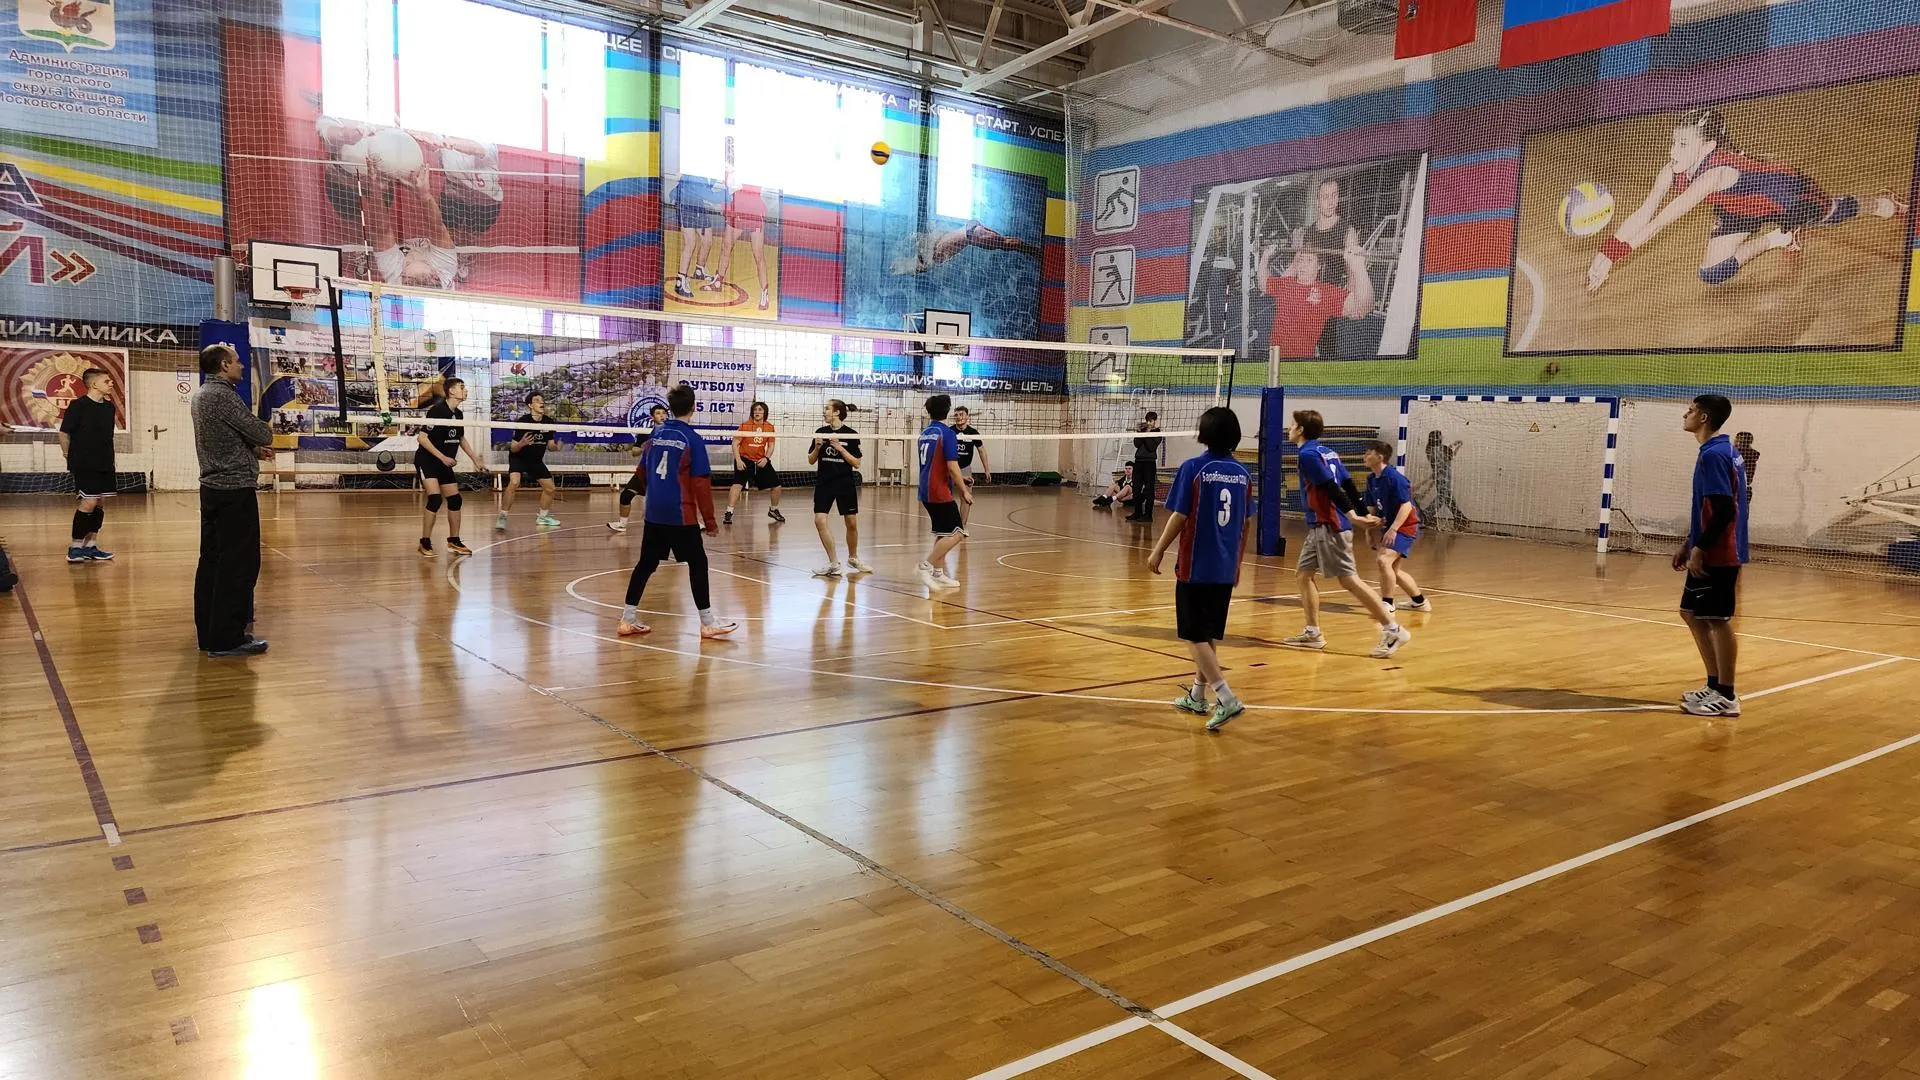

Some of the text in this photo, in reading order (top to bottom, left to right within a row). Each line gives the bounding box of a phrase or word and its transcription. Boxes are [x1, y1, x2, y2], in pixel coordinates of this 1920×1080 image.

[9, 49, 129, 78] Администрация
[28, 68, 112, 90] городского
[13, 81, 125, 106] округа Кашира
[88, 106, 147, 123] области
[975, 113, 1020, 133] СТАРТ
[1029, 124, 1069, 142] УСПЕХ
[853, 371, 936, 386] ГАРМОНИЯ
[946, 377, 1012, 390] СКОРОСТЬ
[1021, 381, 1054, 393] ЦЕЛЬ
[655, 450, 669, 480] 4
[1217, 488, 1232, 527] 3
